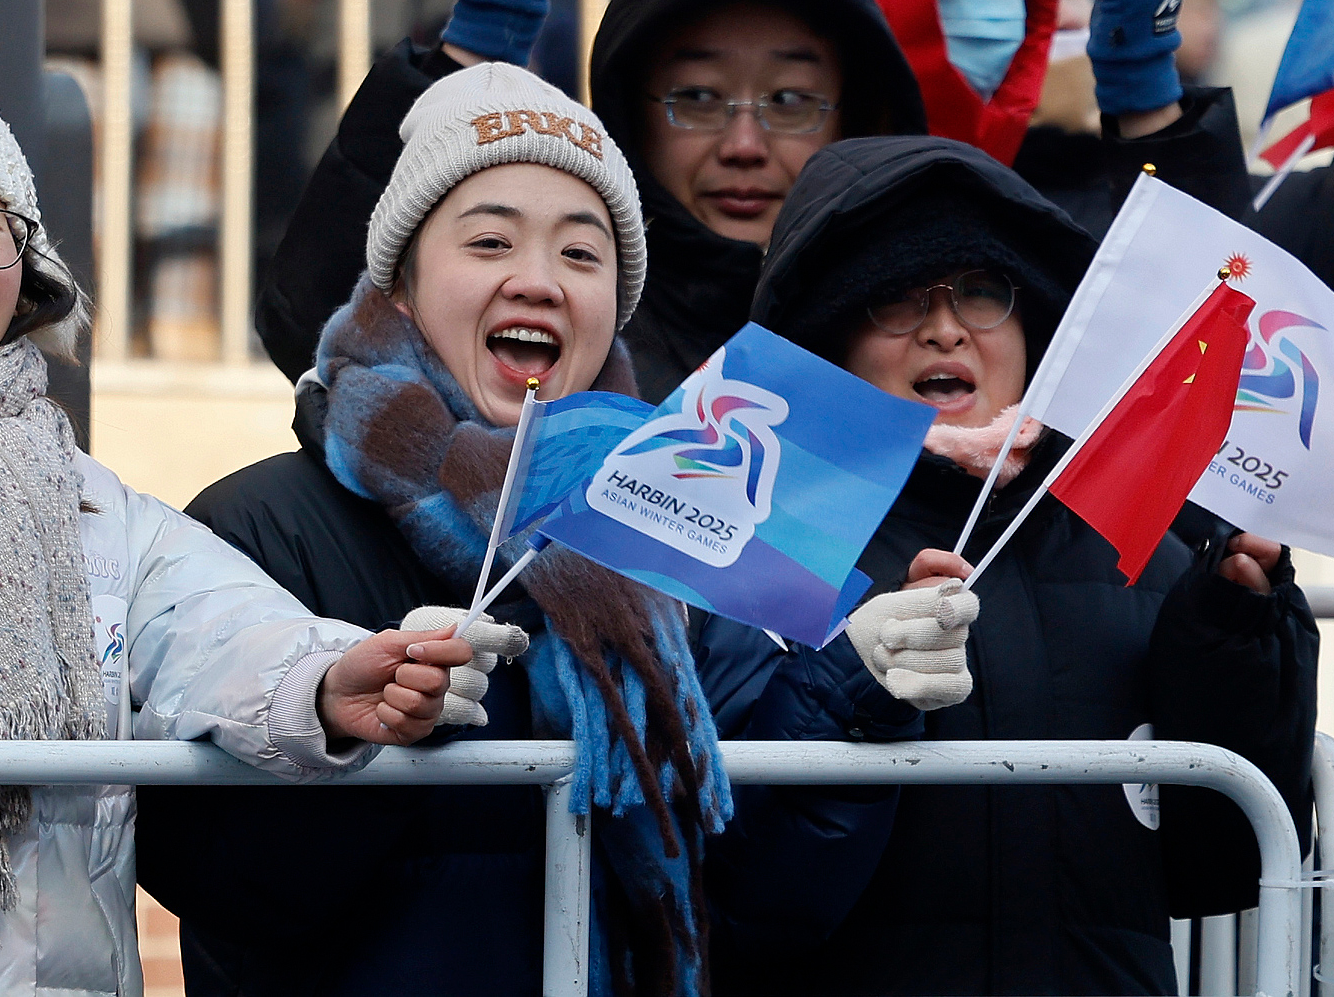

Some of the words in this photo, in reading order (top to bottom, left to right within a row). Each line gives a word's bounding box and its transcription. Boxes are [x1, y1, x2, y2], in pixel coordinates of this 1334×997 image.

[470, 109, 604, 161] ERKE
[1227, 446, 1289, 490] 2025
[1230, 473, 1275, 505] GAMES
[600, 489, 638, 512] ASIAN
[639, 505, 685, 535] WINTER
[687, 530, 728, 555] GAMES
[607, 470, 686, 516] HARBIN
[684, 506, 738, 541] 2025
